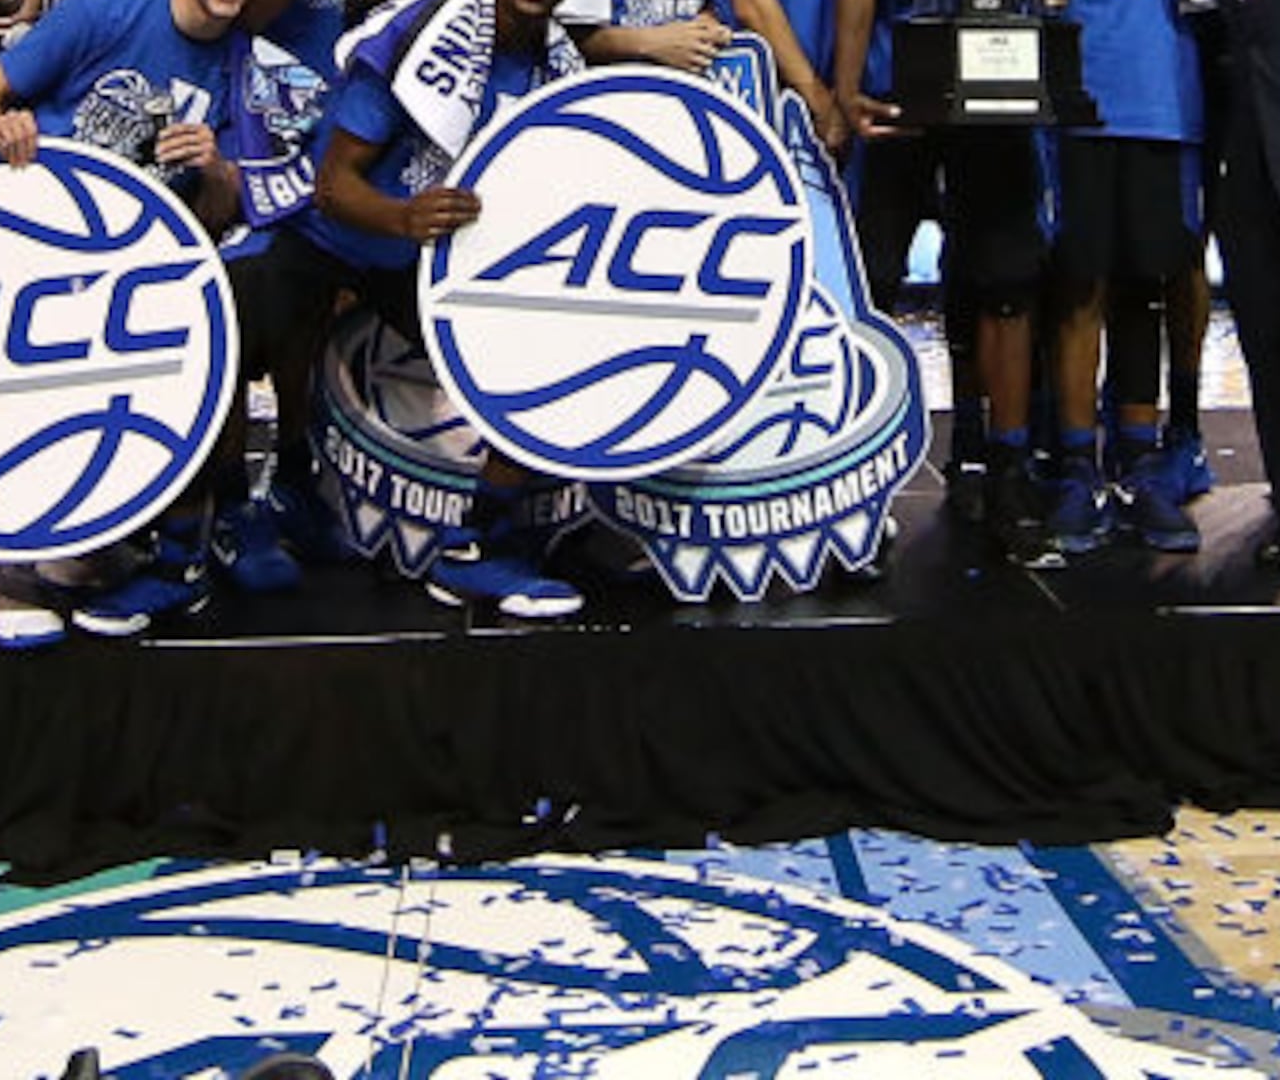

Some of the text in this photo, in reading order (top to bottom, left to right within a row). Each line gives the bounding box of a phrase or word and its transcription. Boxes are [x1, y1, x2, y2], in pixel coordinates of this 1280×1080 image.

[475, 203, 801, 298] ACC
[326, 425, 381, 491] 2017
[616, 432, 910, 534] 2017 TOURNAMENT
